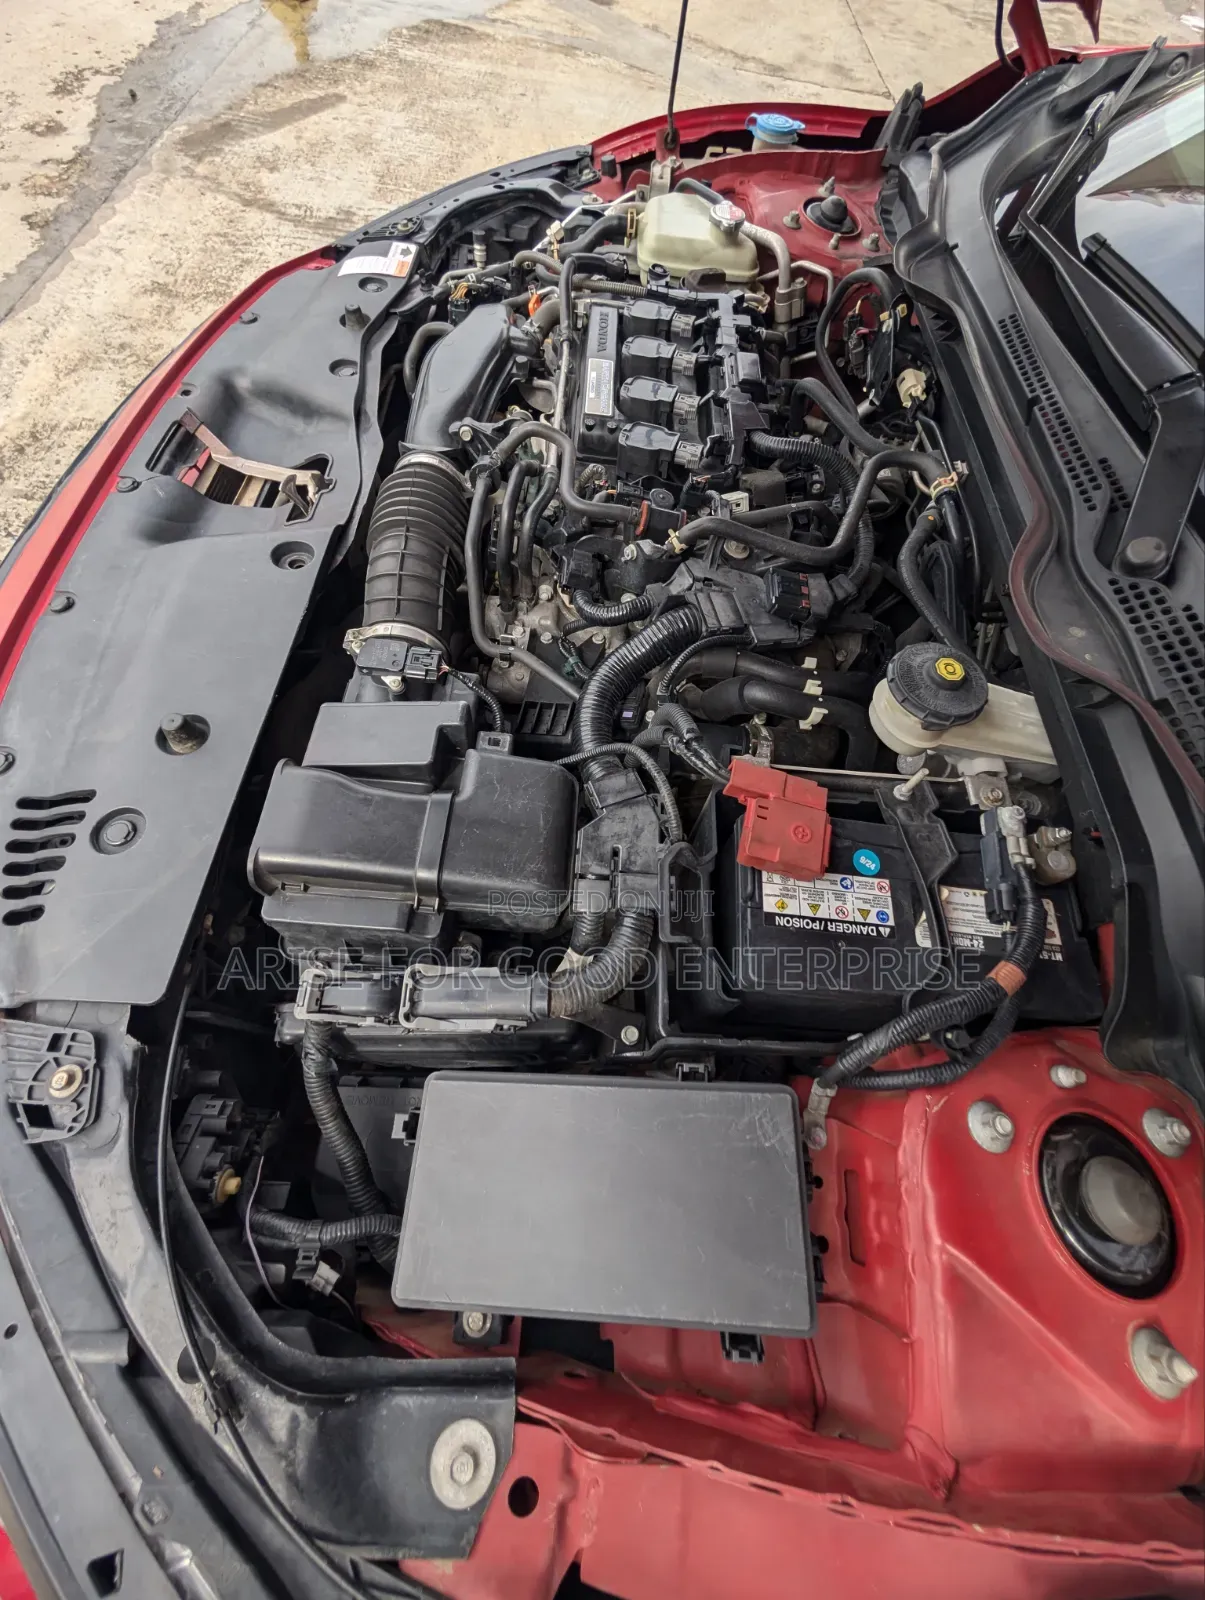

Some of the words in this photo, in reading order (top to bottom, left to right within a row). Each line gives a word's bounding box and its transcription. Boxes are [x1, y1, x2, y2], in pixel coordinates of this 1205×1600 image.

[596, 311, 609, 353] HONDA
[859, 855, 876, 871] 9/24
[775, 915, 820, 930] POISON
[827, 920, 877, 936] DANGER
